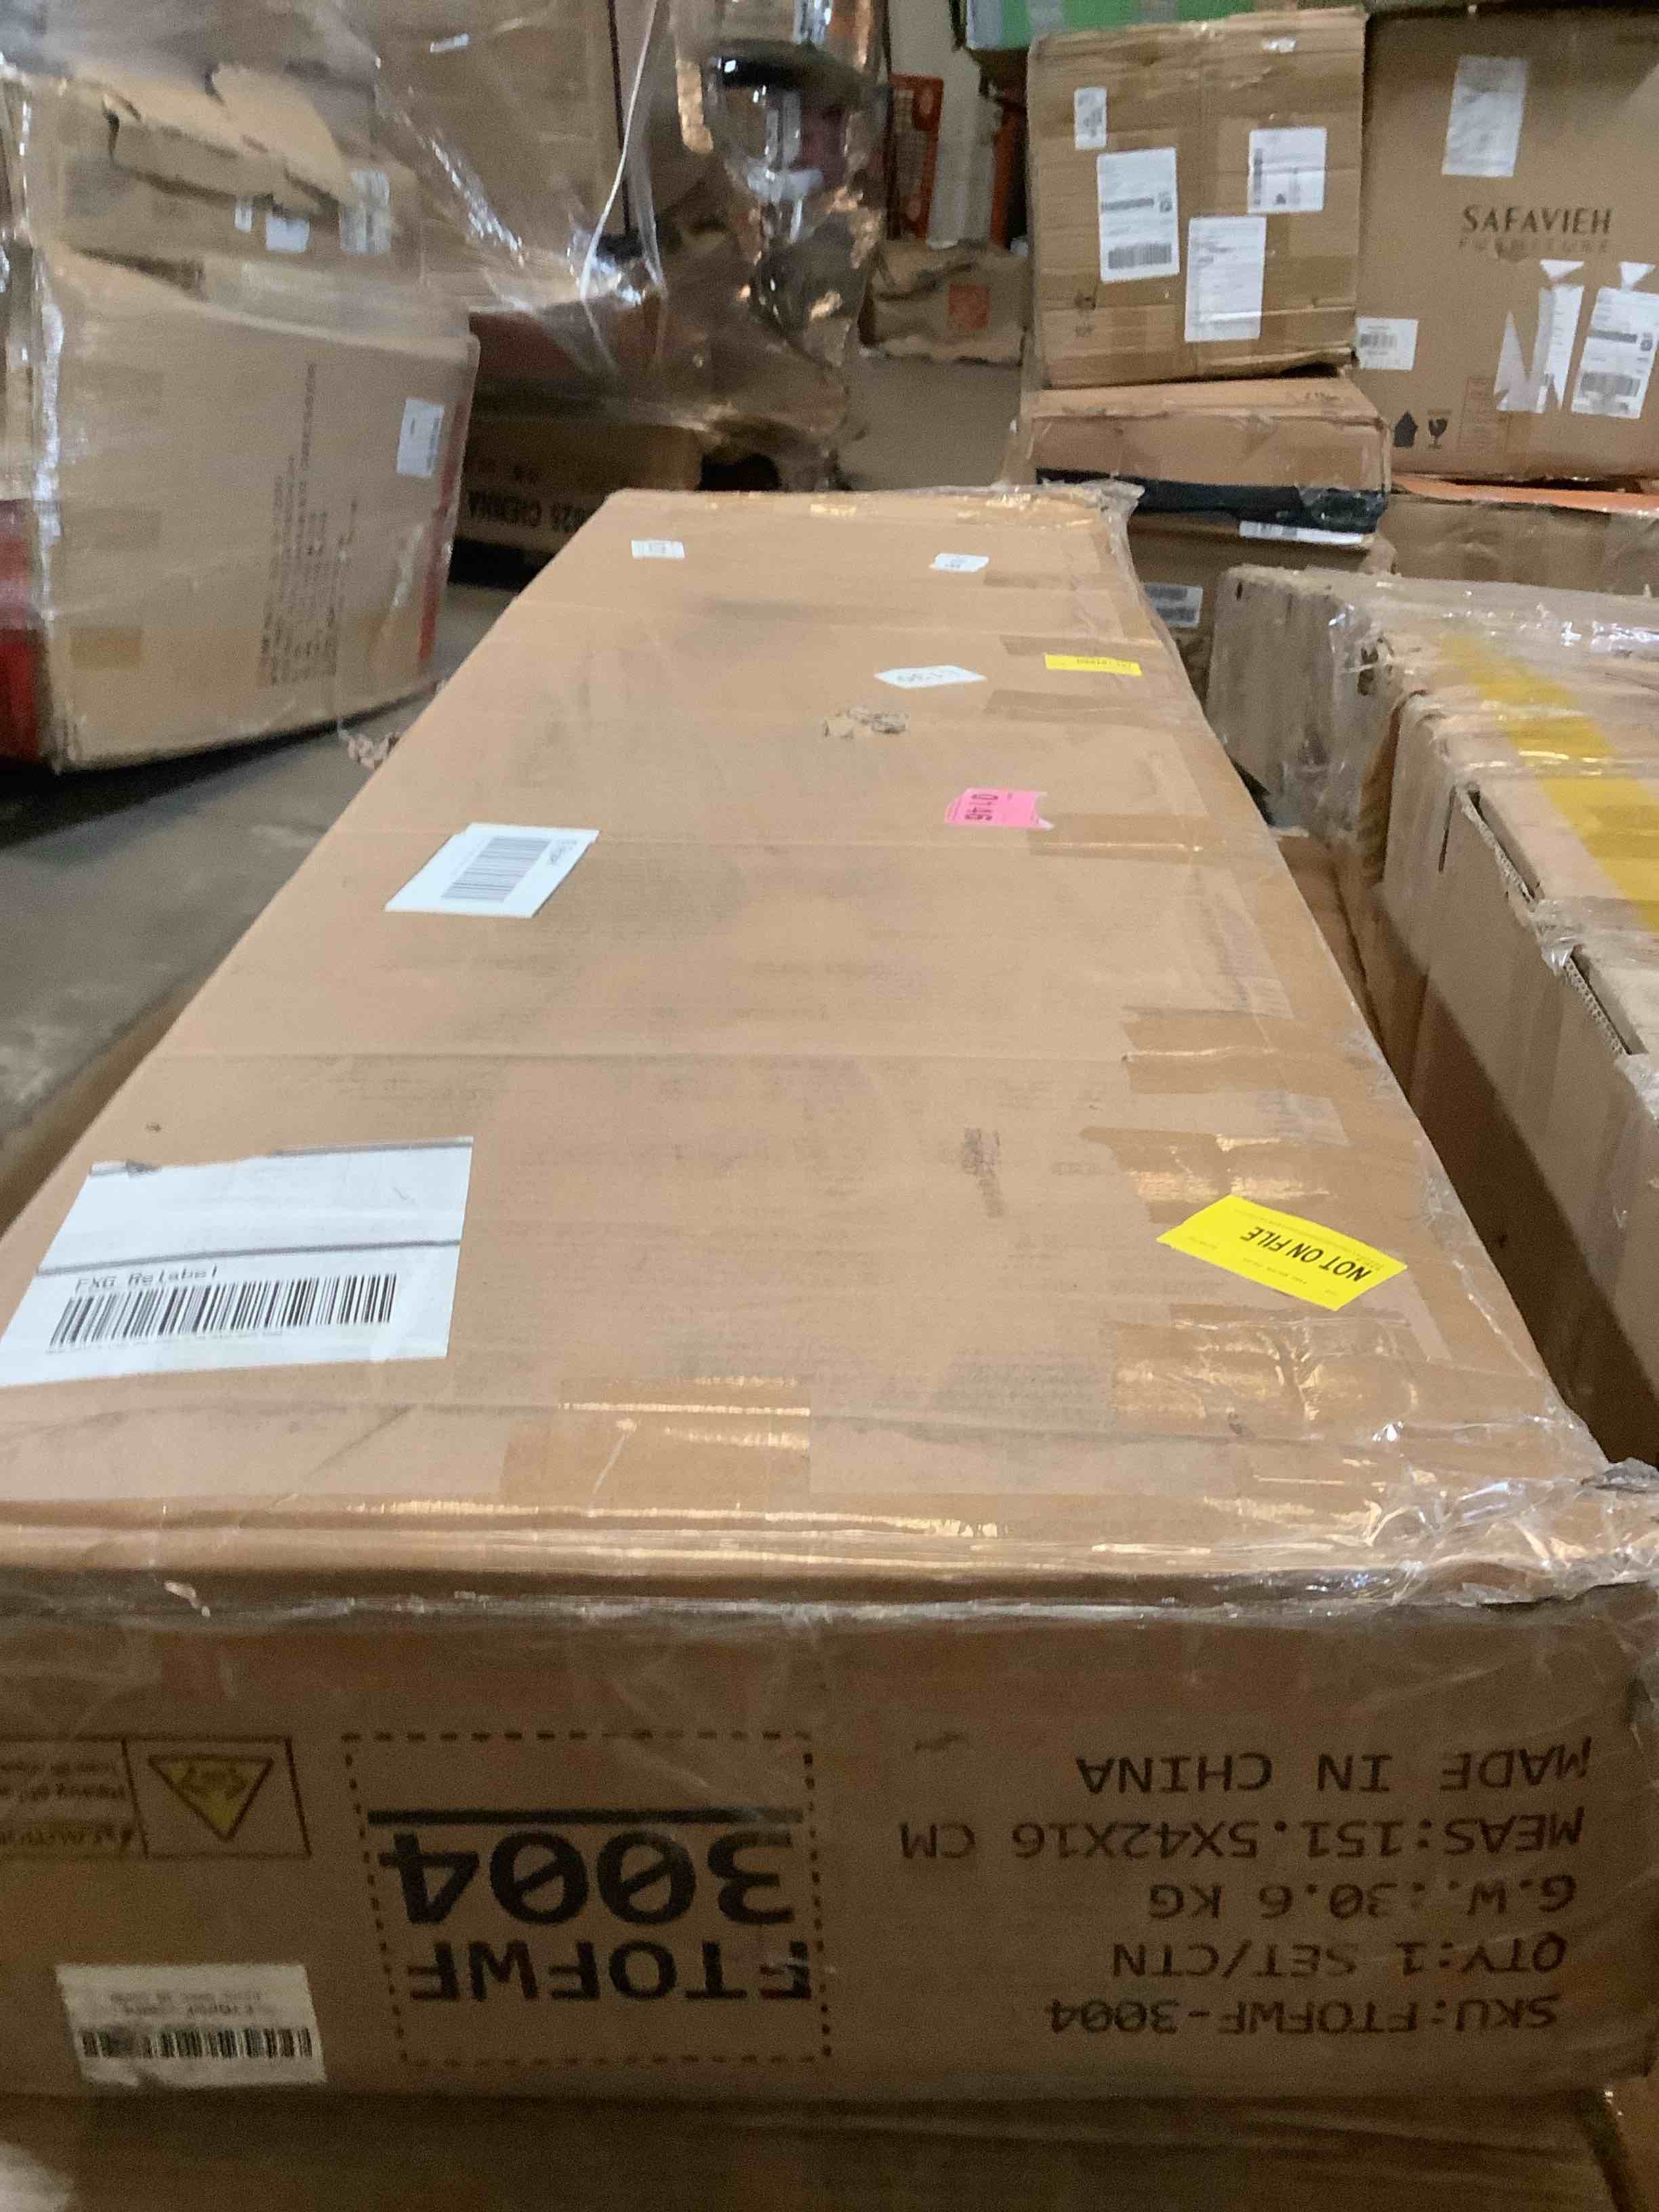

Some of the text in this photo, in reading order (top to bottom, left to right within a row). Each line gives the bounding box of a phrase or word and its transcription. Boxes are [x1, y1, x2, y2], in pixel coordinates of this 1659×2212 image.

[1462, 203, 1614, 234] SAFAVIEH
[1239, 1226, 1293, 1252] FILE
[1286, 1242, 1324, 1261] ON
[127, 1265, 218, 1286] Relabel
[1319, 1255, 1372, 1282] NOT
[1076, 1735, 1593, 1794] MADE IN CHINA
[900, 1805, 1585, 1859] MEAS:151.5X42X16 CM
[378, 1832, 795, 1925] 3004
[1149, 1883, 1222, 1919] KG
[409, 1941, 812, 2001] FTOFWF
[1111, 1930, 1568, 1978] QTY:1 SET/CTN
[1050, 1992, 1563, 2034] SKU:FTOFWF-3004
